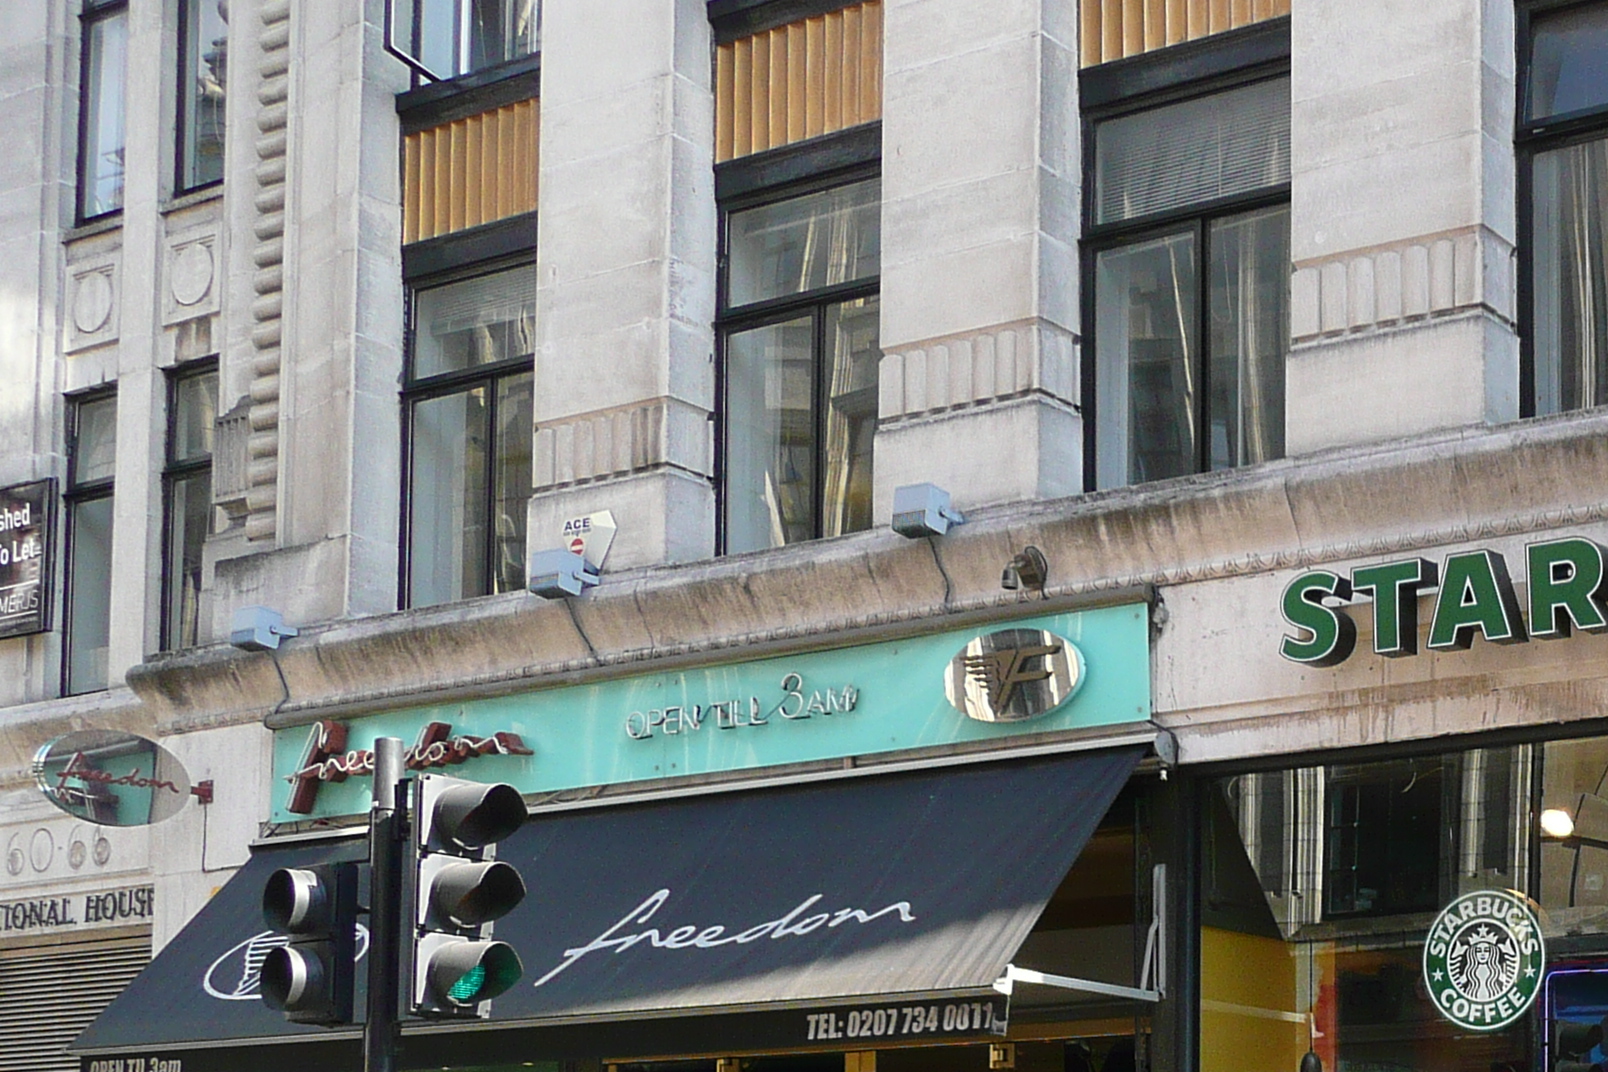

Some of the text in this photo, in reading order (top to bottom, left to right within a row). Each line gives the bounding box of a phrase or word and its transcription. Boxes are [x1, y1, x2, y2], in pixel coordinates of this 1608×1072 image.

[564, 517, 590, 531] ACE
[626, 704, 702, 739] OPEN
[709, 698, 768, 730] TILL
[534, 888, 917, 987] freedom
[1429, 896, 1540, 1023] STARBUCKS COFFEE
[807, 1013, 843, 1041] TEL:
[846, 1008, 898, 1038] 0207
[901, 1006, 938, 1034] 734
